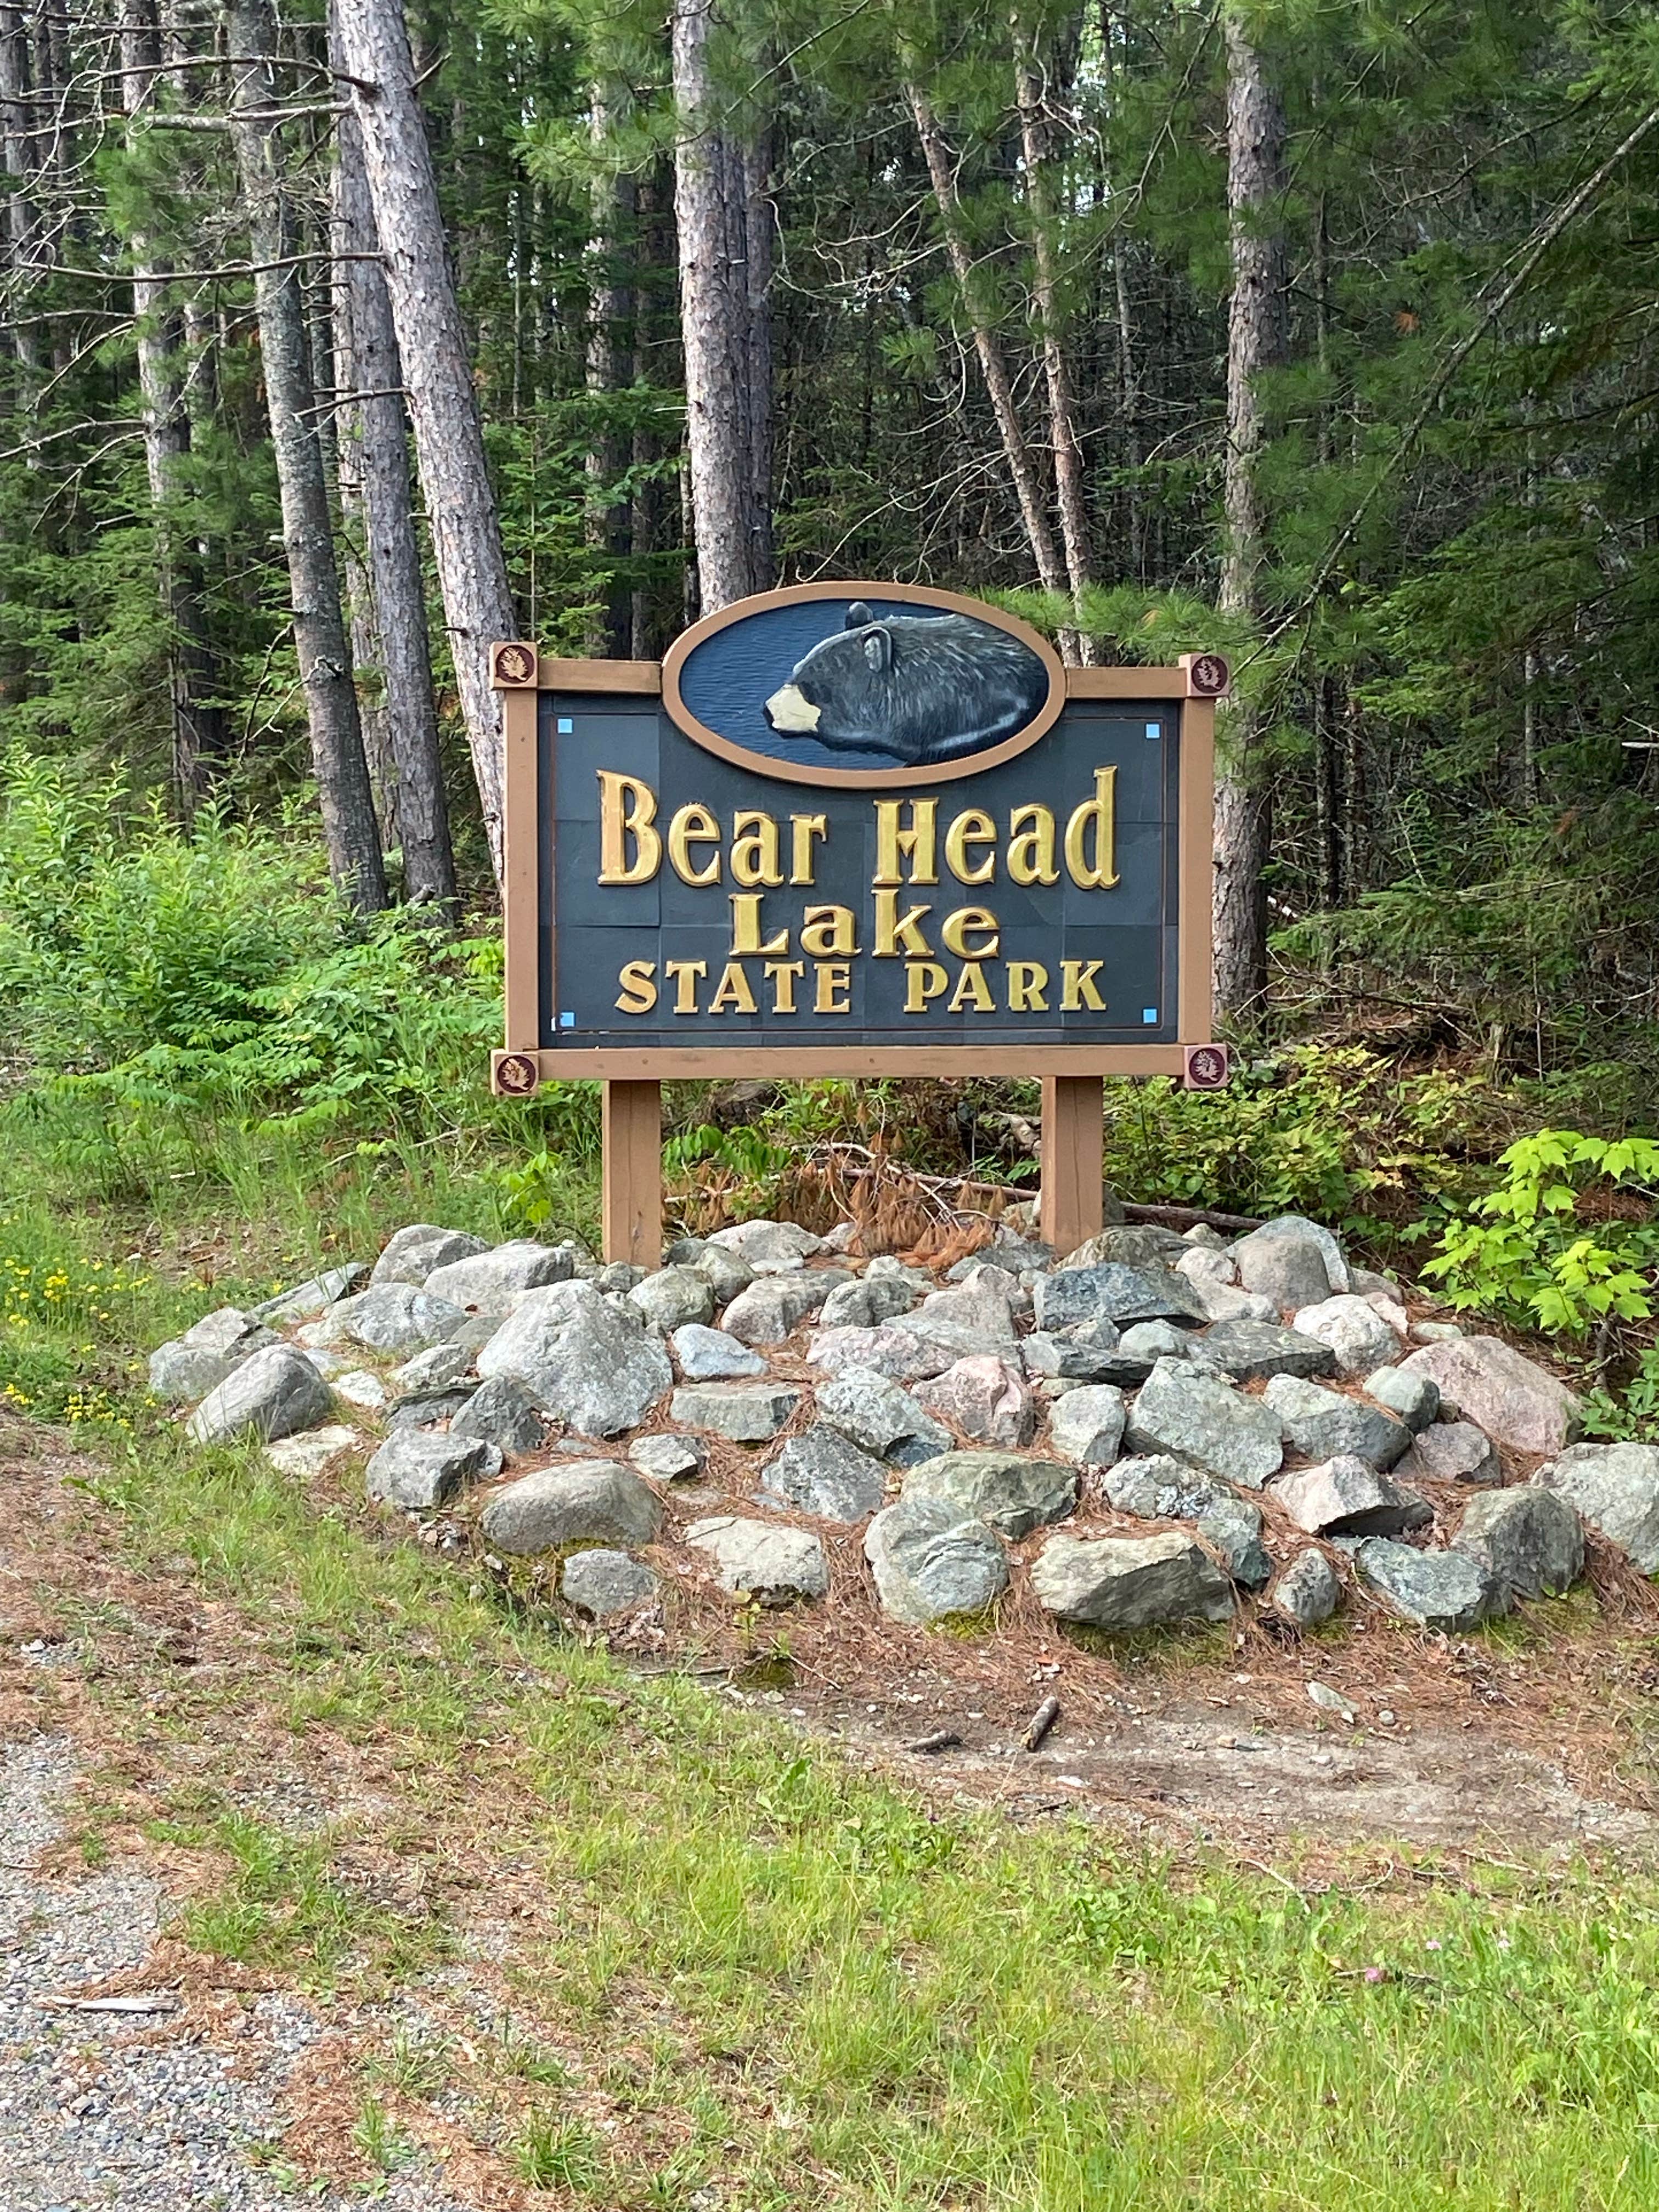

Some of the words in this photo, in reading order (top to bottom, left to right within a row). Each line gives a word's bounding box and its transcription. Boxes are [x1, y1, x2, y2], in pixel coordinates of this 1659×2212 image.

[596, 769, 827, 887] Bear
[873, 765, 1120, 890] Head
[729, 889, 1001, 960] Lake
[615, 960, 851, 1014] STATE
[904, 960, 1107, 1013] PARK
